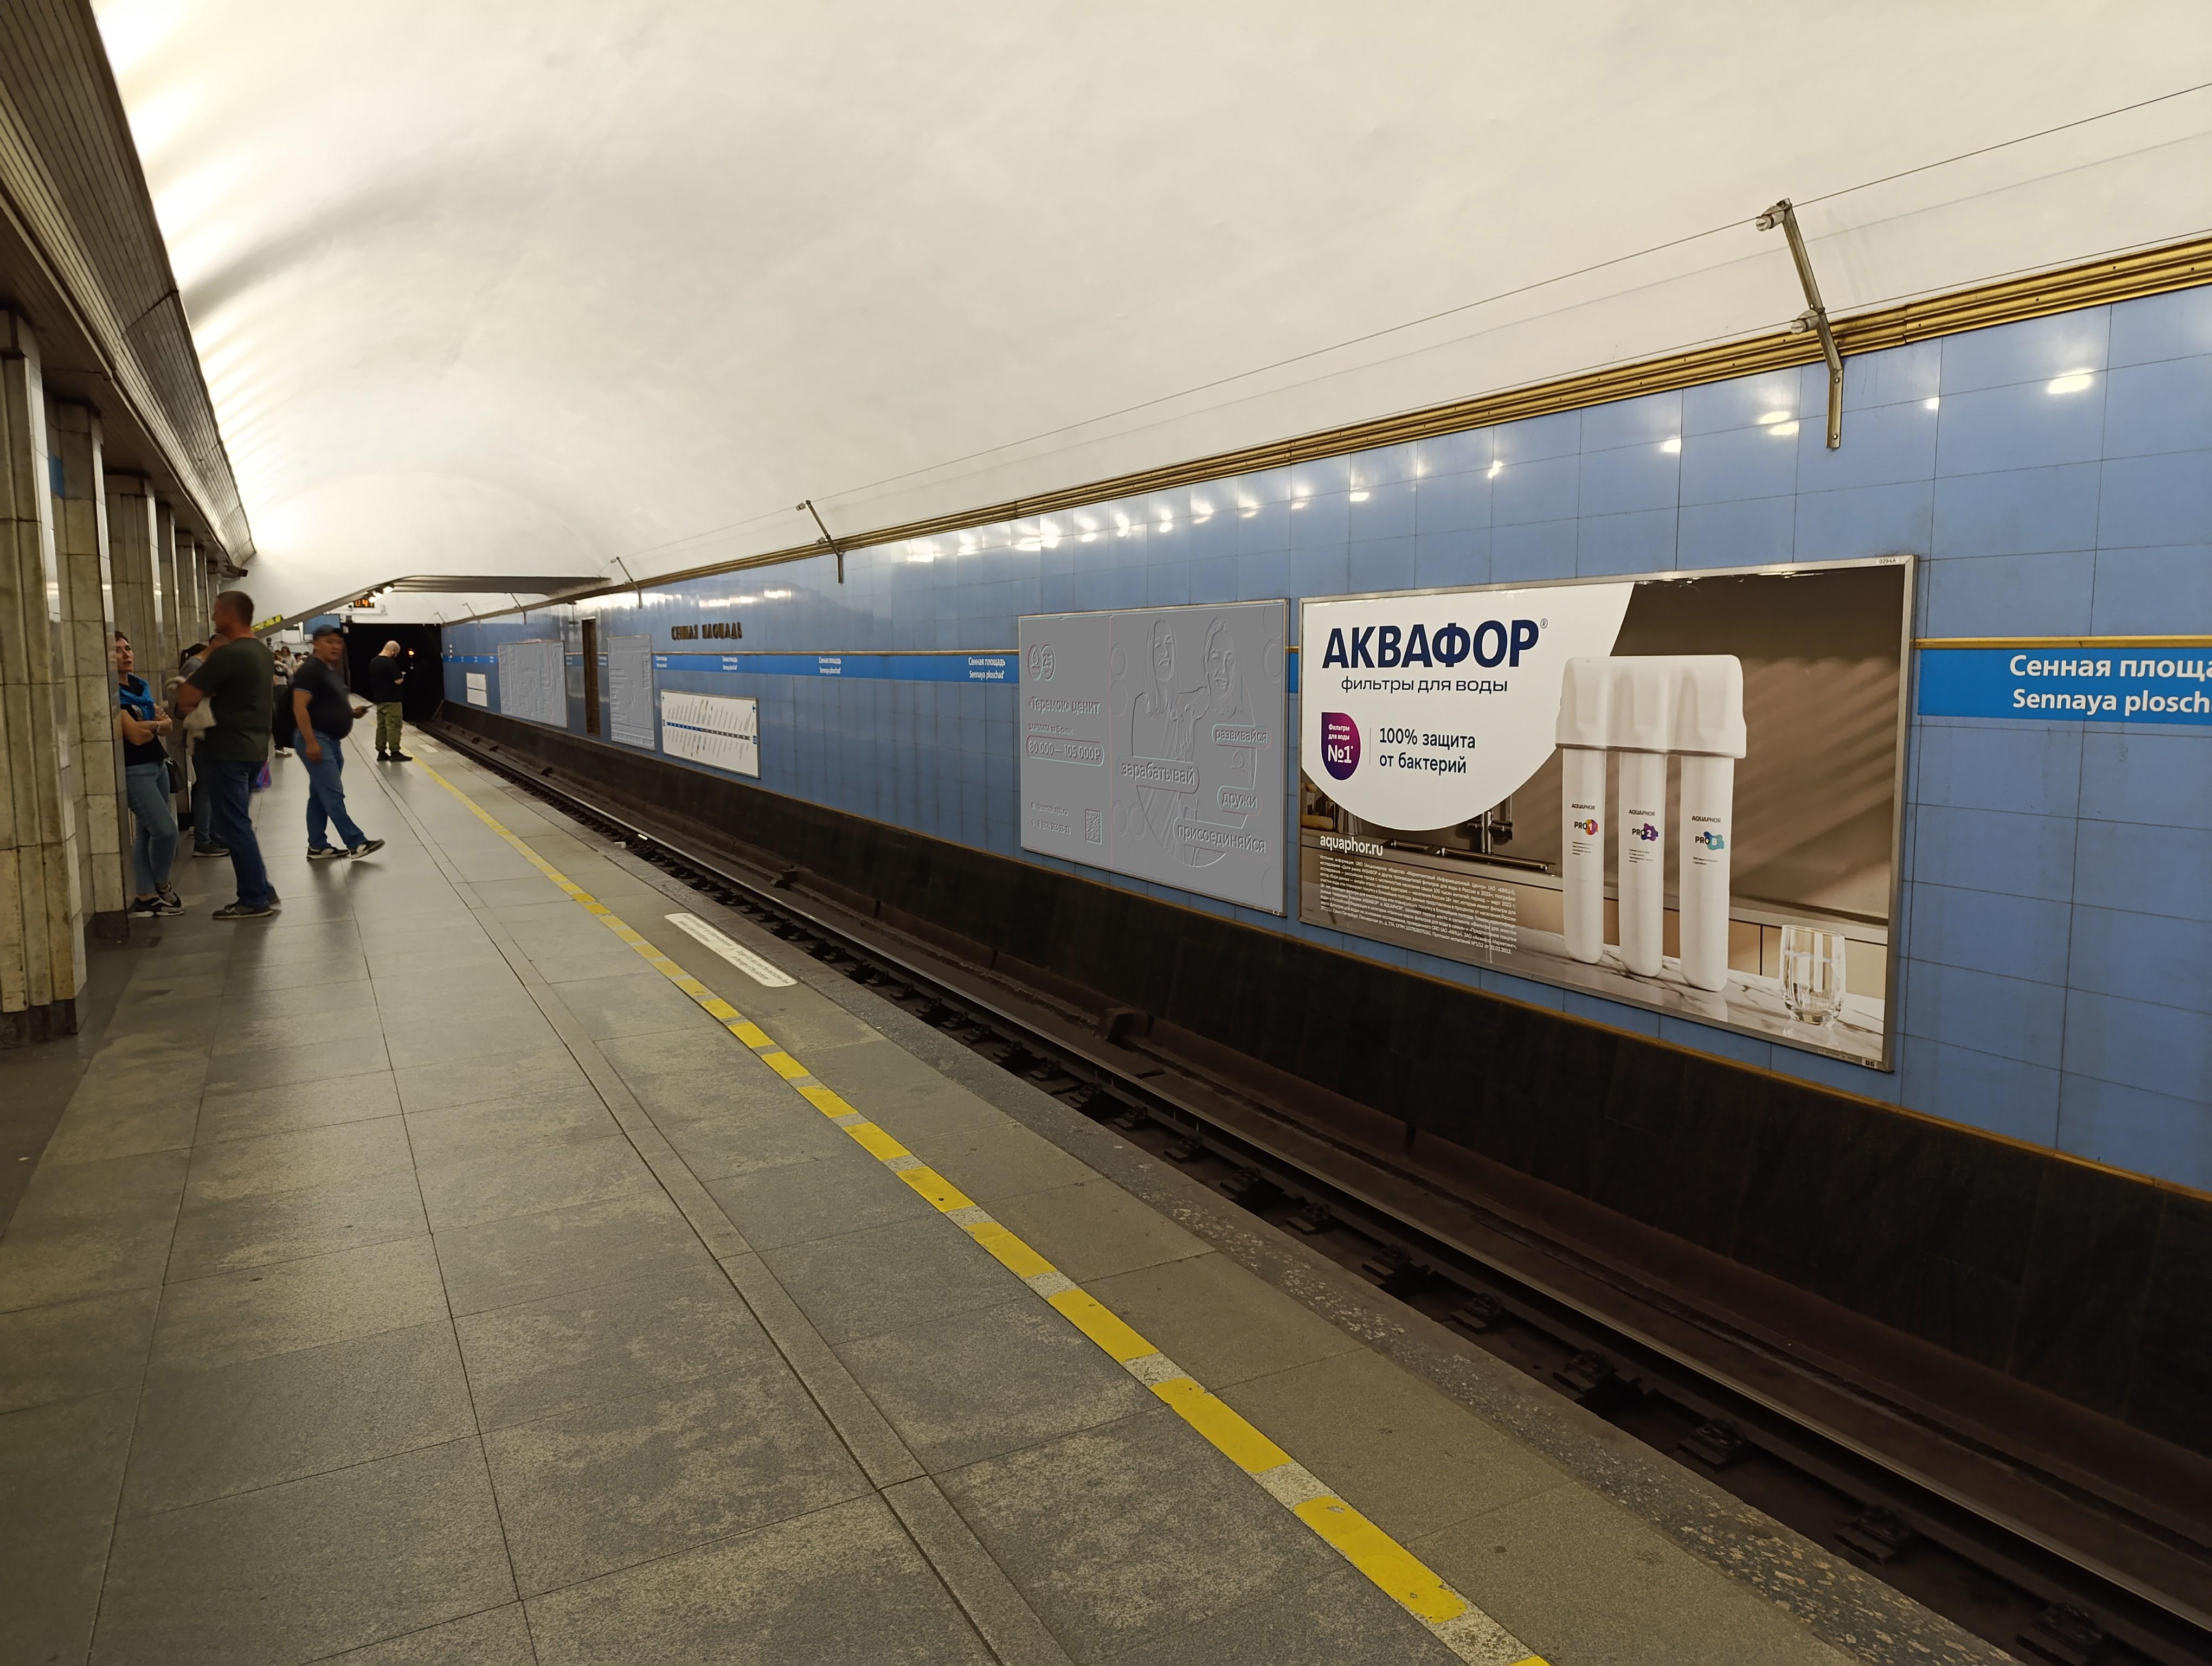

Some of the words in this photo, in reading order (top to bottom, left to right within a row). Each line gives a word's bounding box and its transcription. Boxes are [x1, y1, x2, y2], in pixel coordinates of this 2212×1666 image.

[968, 657, 984, 665] Сенная
[985, 659, 1006, 667] площадь
[2010, 655, 2112, 677] Сенная
[969, 670, 985, 680] Sennaya
[1341, 676, 1414, 693] фильтры
[1418, 680, 1451, 693] для
[1456, 680, 1508, 694] воды
[1072, 701, 1100, 715] ценит
[2013, 689, 2117, 715] Sennaya
[2125, 690, 2212, 716] plosch
[1215, 729, 1268, 744] развивайся
[1328, 723, 1349, 732] Фильтры
[1380, 727, 1418, 745] 100%
[1422, 733, 1475, 751] защита
[1029, 740, 1038, 753] 80
[1040, 742, 1054, 755] 000
[1064, 745, 1077, 758] 105
[1122, 761, 1194, 785] зарабатывай
[1379, 754, 1394, 767] от
[1398, 752, 1467, 776] бактерий
[1222, 792, 1257, 809] дружи
[1177, 825, 1266, 853] присоединяйся
[1320, 835, 1383, 856] aquaphor.ru
